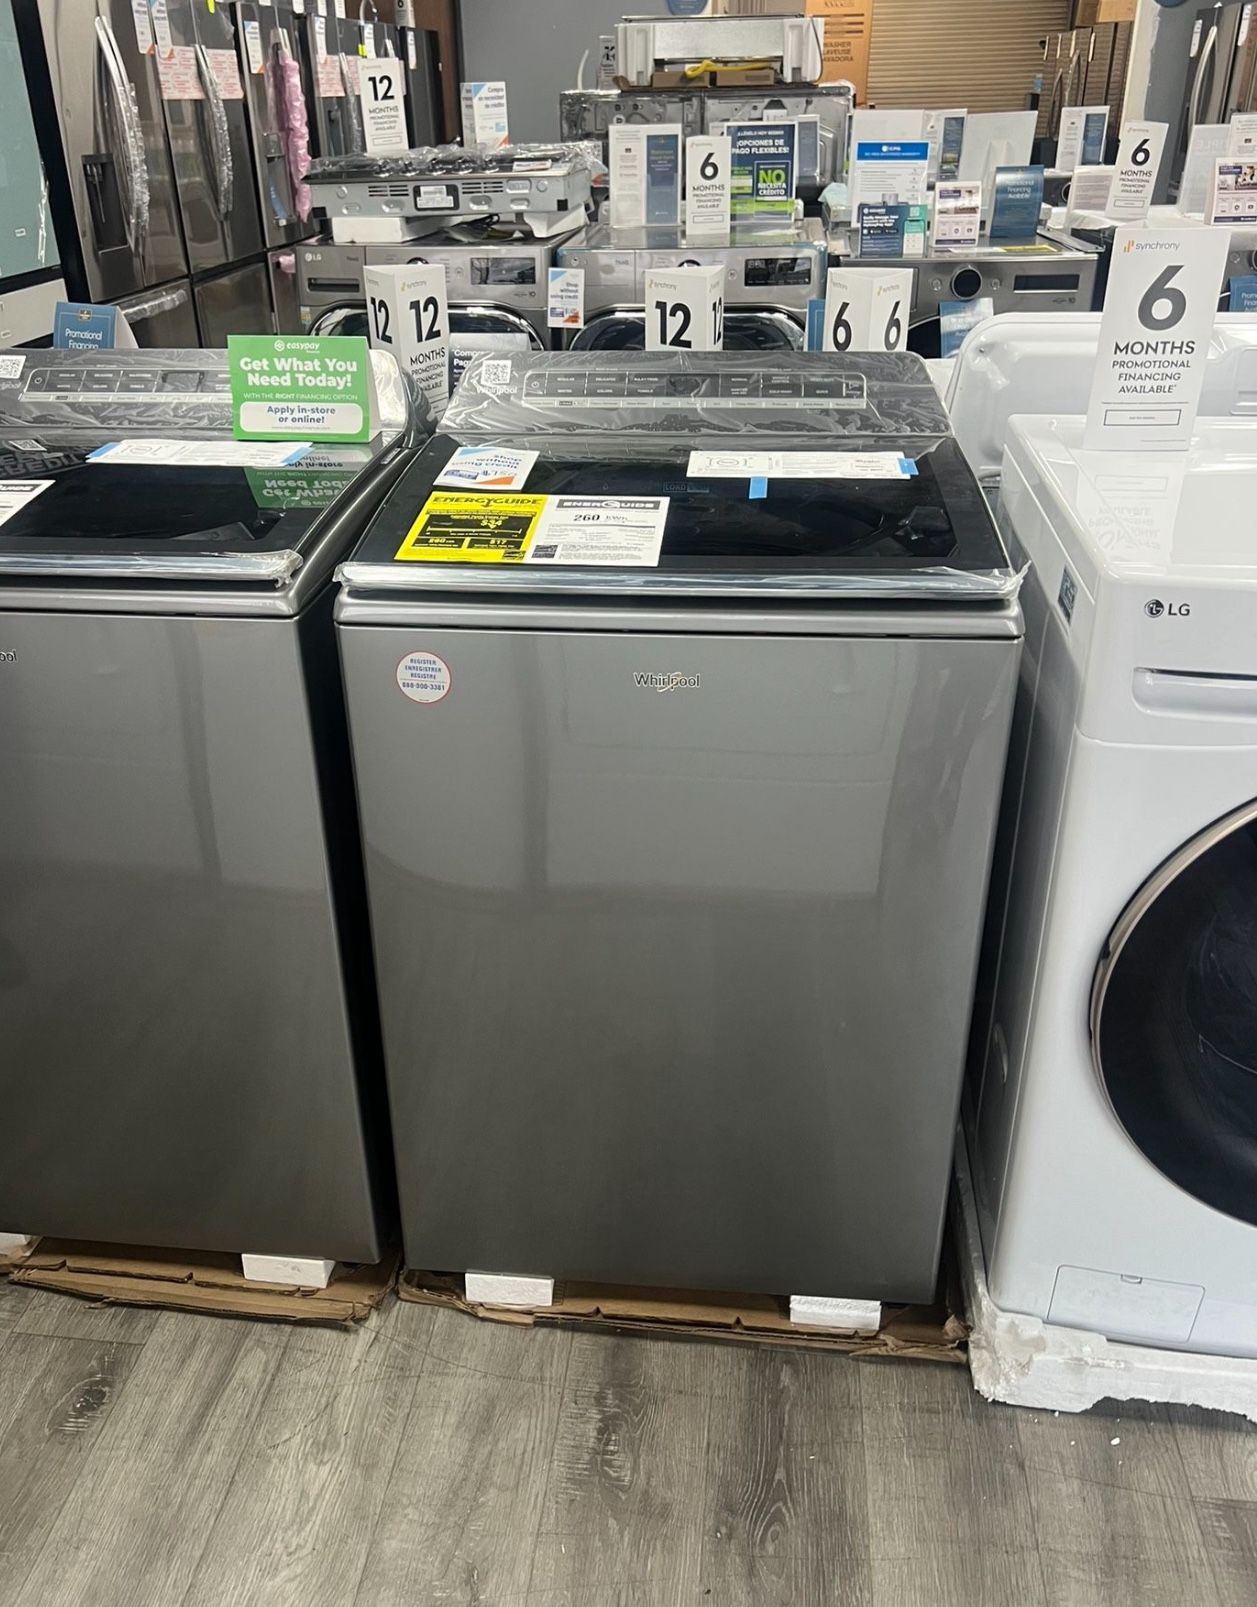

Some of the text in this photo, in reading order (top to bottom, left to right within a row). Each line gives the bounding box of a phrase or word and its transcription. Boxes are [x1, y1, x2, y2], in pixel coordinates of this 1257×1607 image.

[368, 75, 395, 101] 12
[368, 105, 399, 114] MONTHS
[1131, 138, 1150, 166] 6
[700, 152, 719, 181] 6
[759, 169, 785, 184] NO
[692, 184, 725, 192] MONTHS
[1138, 265, 1187, 331] 6
[370, 296, 441, 344] 12 12
[655, 300, 692, 349] 12
[832, 300, 901, 351] 6 6
[65, 328, 103, 340] Promotional
[286, 342, 320, 352] easypay
[1114, 340, 1196, 355] MONTHS
[410, 347, 446, 366] MONTHS
[1112, 359, 1191, 369] PROMOTIONAL
[240, 357, 358, 372] Get What You
[247, 372, 352, 390] Need Today!
[1118, 372, 1181, 382] FINANCING
[267, 405, 336, 415] Apply in-store
[291, 415, 325, 423] online!
[573, 513, 601, 522] 260
[1168, 603, 1191, 617] LG
[410, 658, 437, 666] REGISTER
[633, 671, 701, 691] Whirlpool
